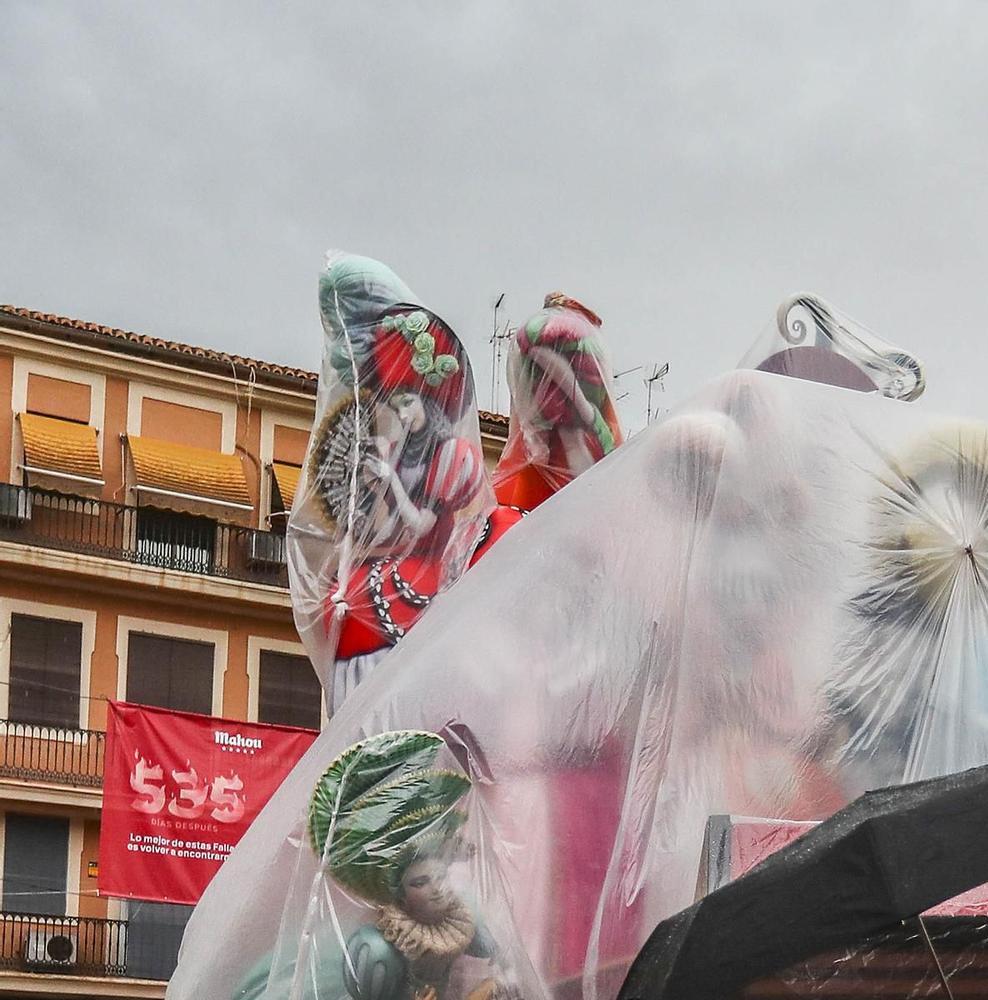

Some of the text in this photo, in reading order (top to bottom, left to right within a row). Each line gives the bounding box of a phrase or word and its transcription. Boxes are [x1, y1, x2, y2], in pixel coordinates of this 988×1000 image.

[215, 731, 262, 749] Mahou
[129, 755, 247, 823] 535
[127, 843, 139, 852] es
[140, 844, 169, 855] volver
[130, 832, 142, 842] Lo
[143, 835, 171, 846] mejor
[172, 838, 184, 848] de
[185, 840, 212, 850] estas
